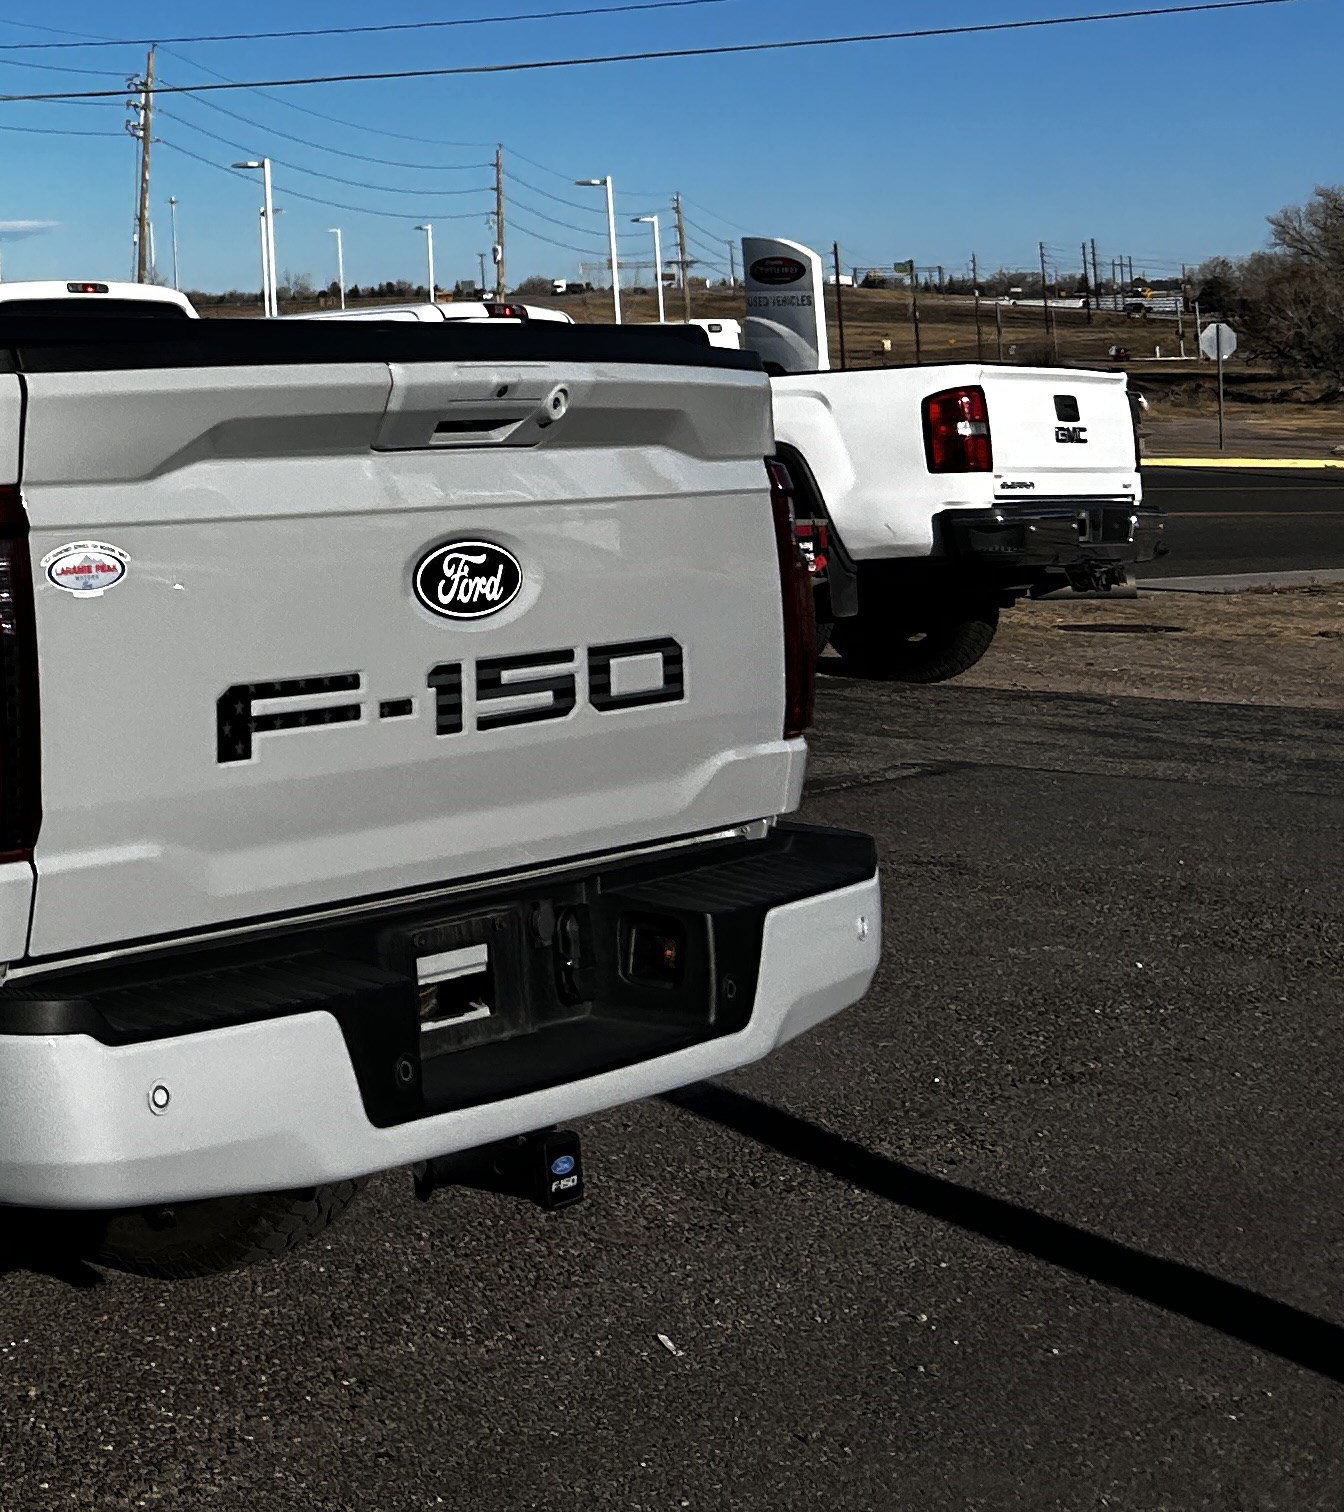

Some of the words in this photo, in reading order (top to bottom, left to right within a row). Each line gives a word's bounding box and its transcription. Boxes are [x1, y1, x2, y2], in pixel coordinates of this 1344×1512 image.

[1054, 426, 1088, 444] GMC
[437, 552, 504, 605] Ford
[216, 636, 685, 764] F-150
